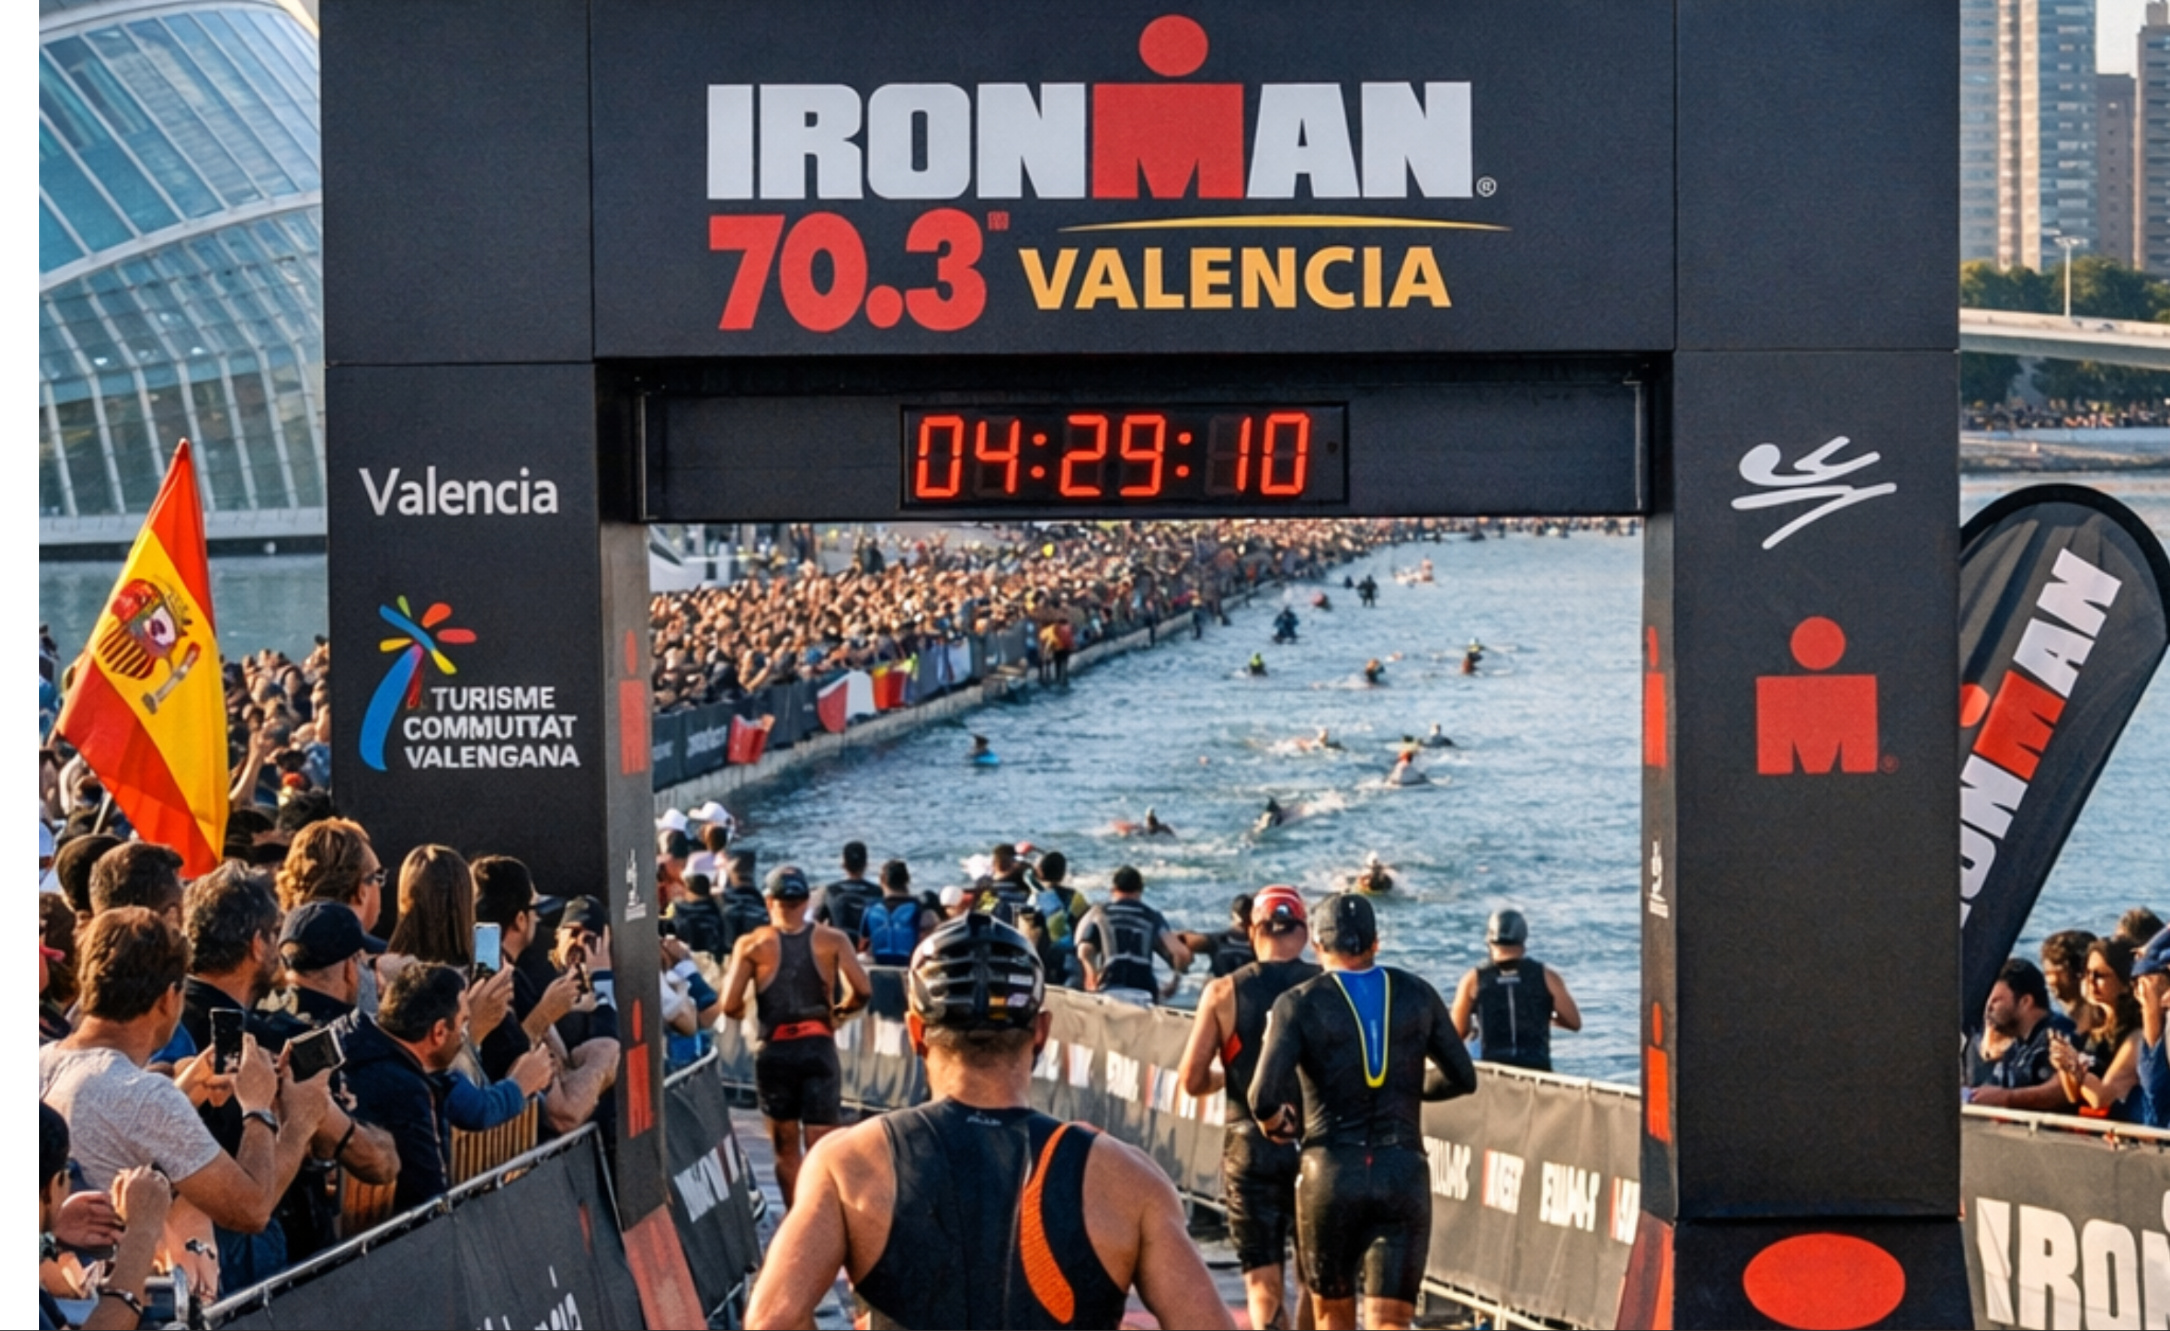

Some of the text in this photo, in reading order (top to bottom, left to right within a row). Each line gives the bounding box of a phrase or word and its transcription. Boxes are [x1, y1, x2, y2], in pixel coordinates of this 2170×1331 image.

[708, 207, 1452, 332] 70.3 VALENCIA
[916, 413, 1311, 498] 04:29:10
[358, 465, 558, 517] Valencia
[430, 686, 556, 712] TURISME
